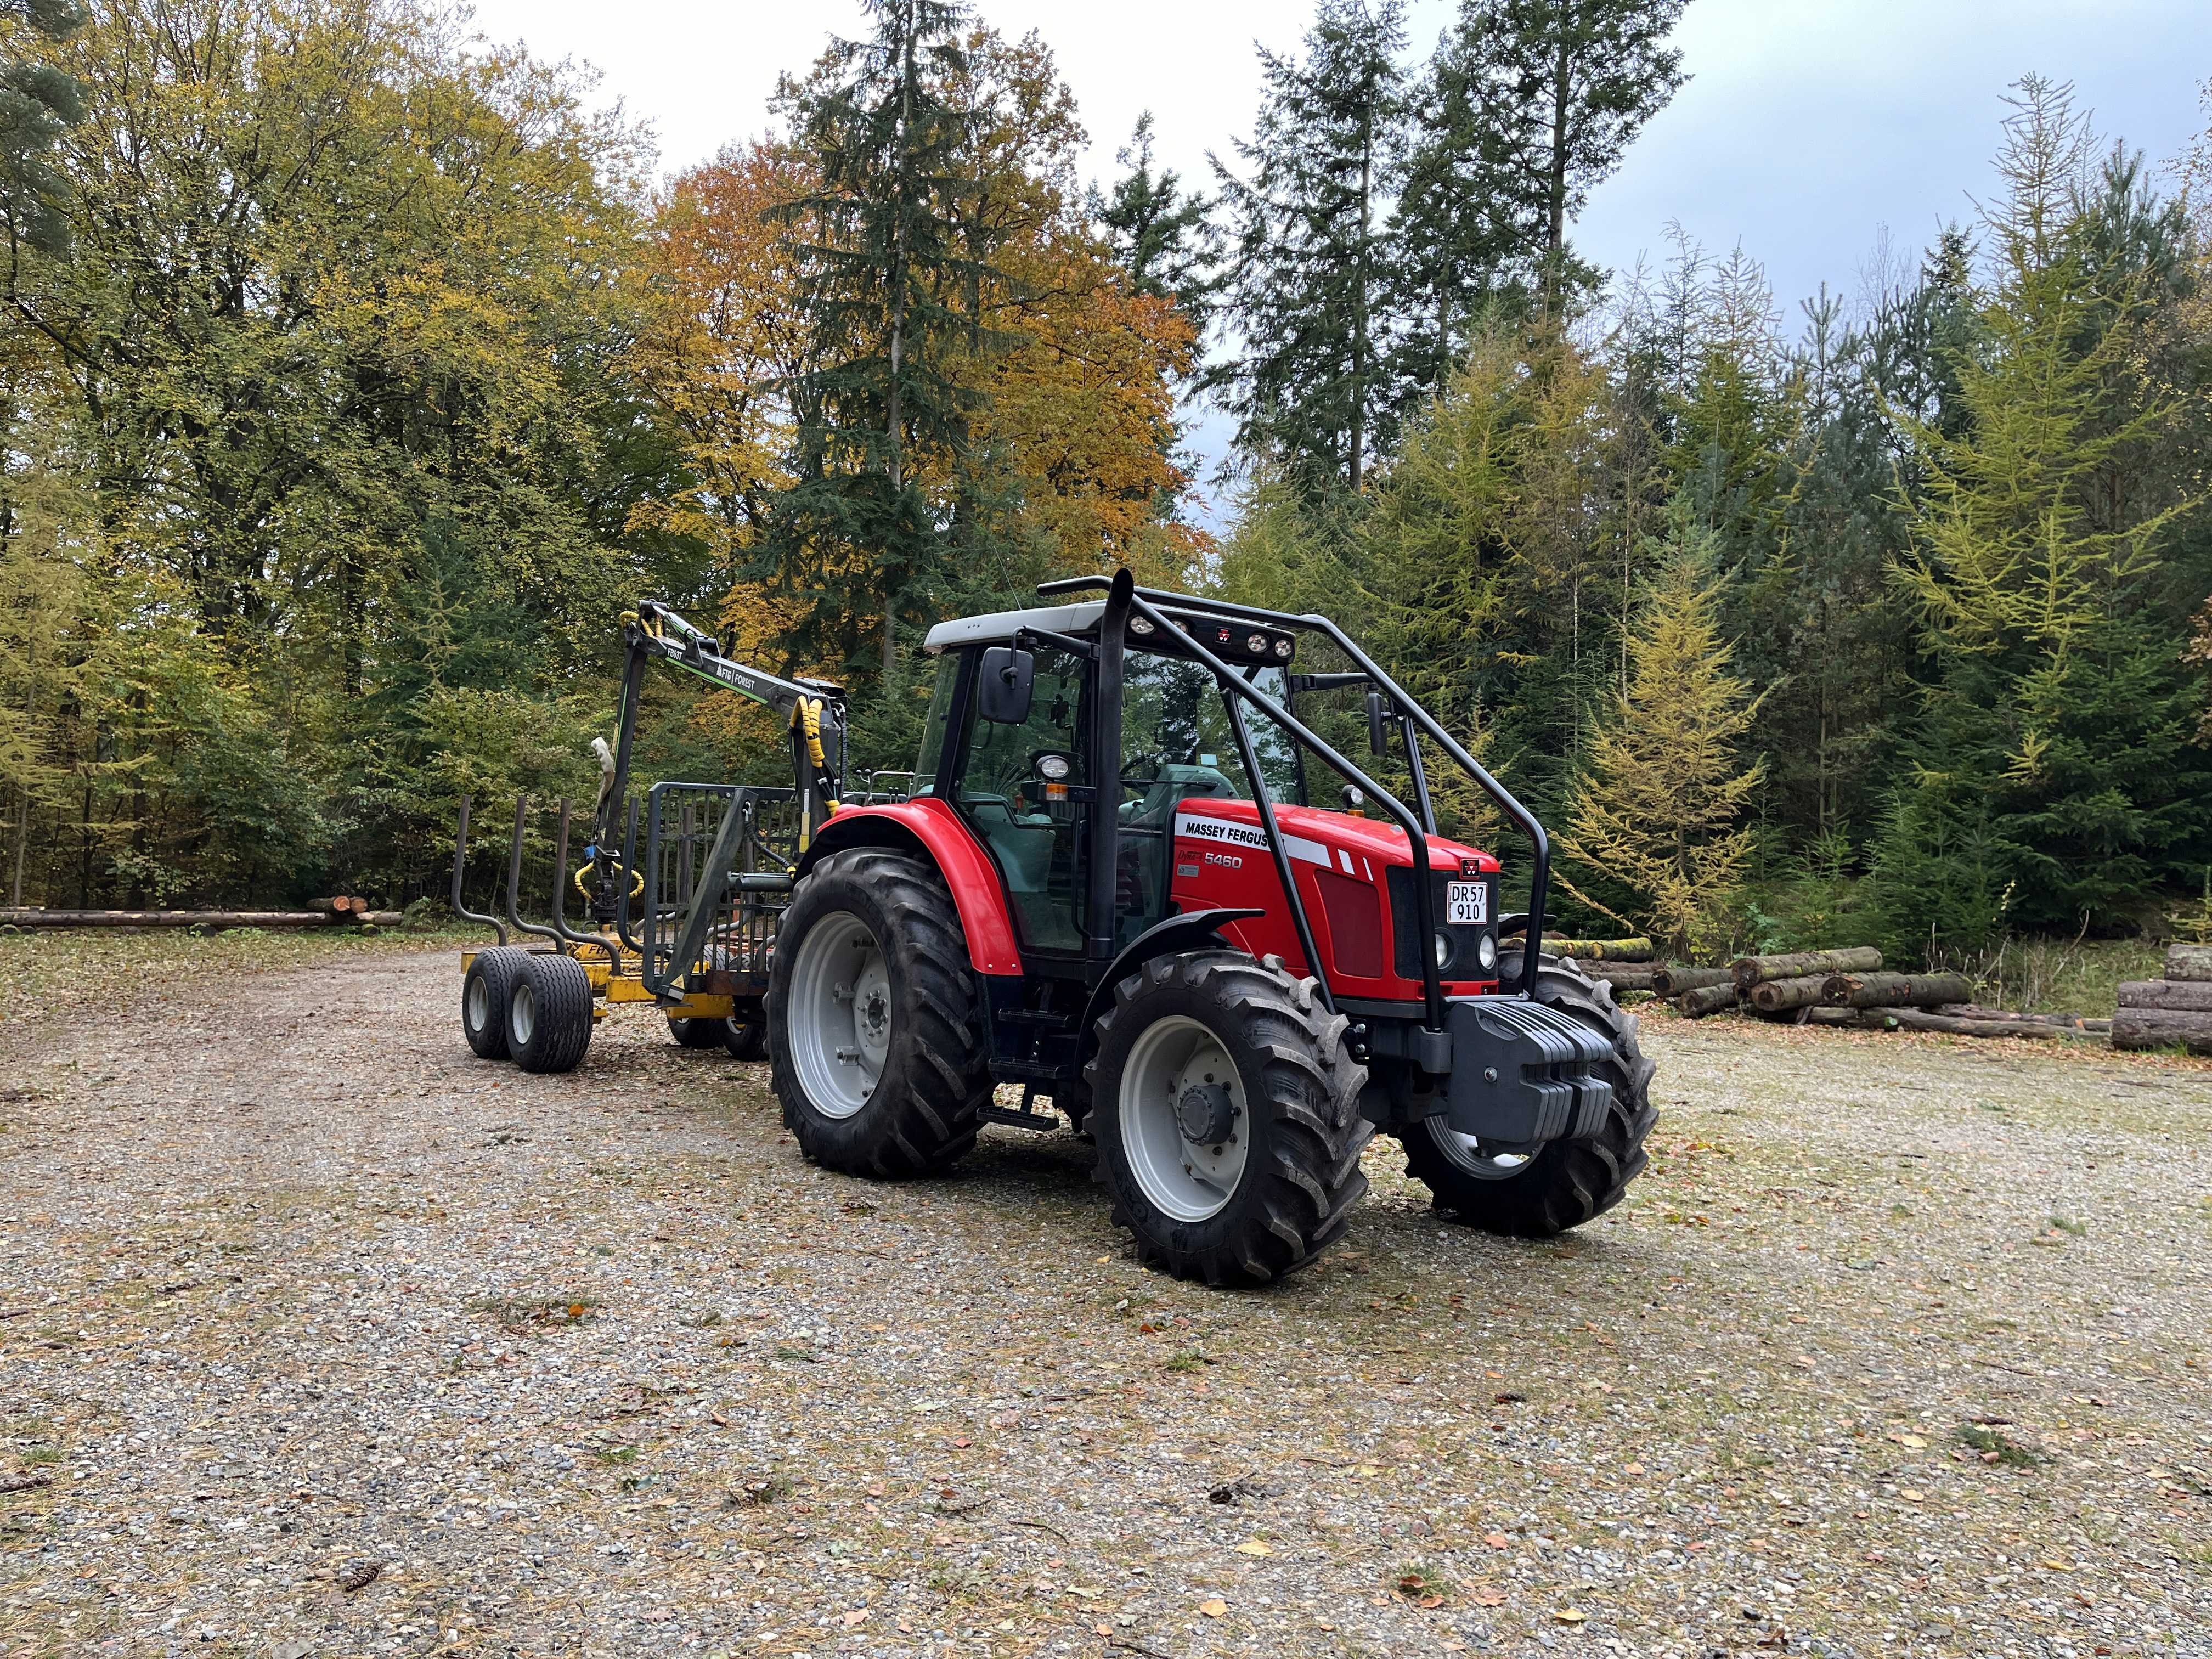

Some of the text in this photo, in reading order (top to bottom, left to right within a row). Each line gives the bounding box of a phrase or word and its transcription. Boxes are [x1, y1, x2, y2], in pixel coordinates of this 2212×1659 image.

[735, 674, 755, 690] FOREST
[1186, 822, 1285, 847] MASSEY FERGUS
[1204, 853, 1242, 869] 5460
[1457, 904, 1480, 920] 910
